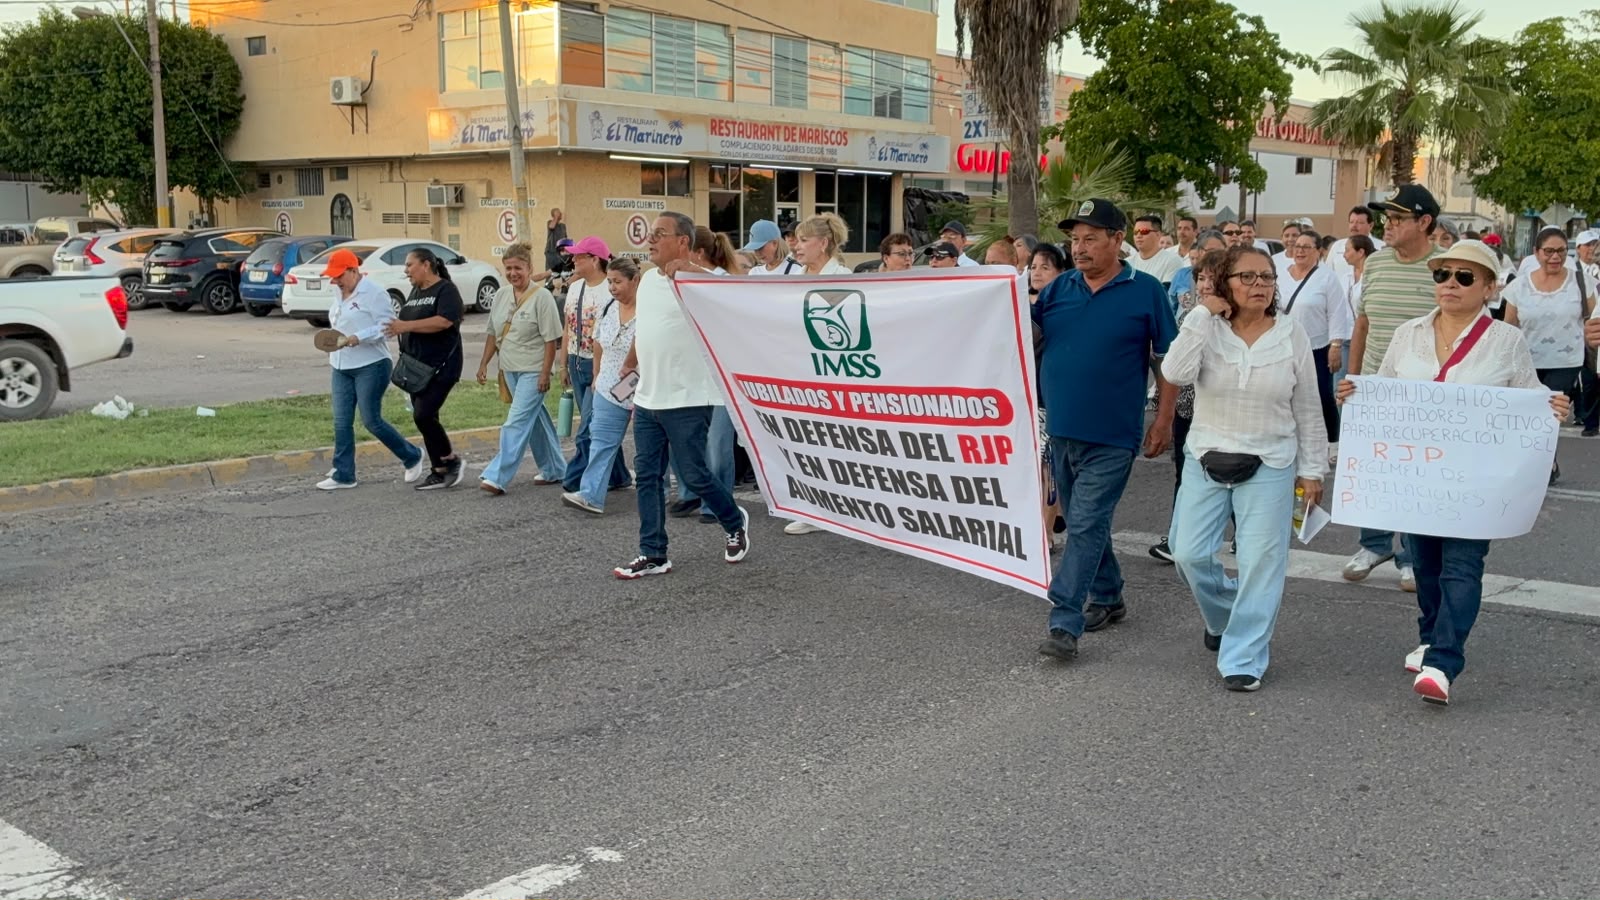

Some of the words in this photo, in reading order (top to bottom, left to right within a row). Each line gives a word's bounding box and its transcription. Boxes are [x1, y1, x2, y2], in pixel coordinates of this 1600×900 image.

[461, 125, 475, 144] El
[477, 124, 535, 143] Mariro
[470, 116, 507, 125] RESTAURAN
[616, 117, 658, 126] RESTAURANT
[710, 118, 780, 142] RESTAURANT
[783, 126, 797, 142] DE
[798, 127, 848, 147] MARISCOS
[606, 123, 621, 141] El
[624, 124, 683, 146] Marinero
[720, 140, 771, 151] COMPLACIENDO
[772, 144, 806, 154] PALADARES
[806, 147, 824, 155] DESDE
[889, 147, 929, 163] Marinero
[480, 199, 509, 207] EXCLUSIVO
[605, 200, 635, 209] EXCLUSIVO
[636, 201, 665, 210] CLIENTES
[810, 352, 882, 379] IMSS
[831, 390, 846, 412] Y
[848, 391, 1000, 420] PENSIONADOS
[1352, 380, 1446, 405] APOYANDO
[1456, 386, 1467, 407] A
[1473, 387, 1509, 410] LOS
[1349, 402, 1468, 425] TRABAJADORES
[1485, 412, 1554, 434] ACTIVOS
[753, 407, 784, 440] EN
[781, 416, 899, 457] DEFENSA
[898, 430, 956, 463] DEL
[956, 433, 1014, 466] RJP
[1342, 422, 1376, 440] PARA
[1520, 434, 1553, 453] DEL
[777, 444, 795, 471] Y
[793, 451, 829, 482] EN
[827, 458, 950, 502] DEFENSA
[949, 475, 1009, 509] DEL
[1347, 456, 1426, 478] REGIMEN
[1440, 467, 1465, 483] DE
[1343, 474, 1486, 508] JUBILACIONES
[786, 474, 896, 530] AUMENTO
[897, 506, 1028, 562] SALARIAL
